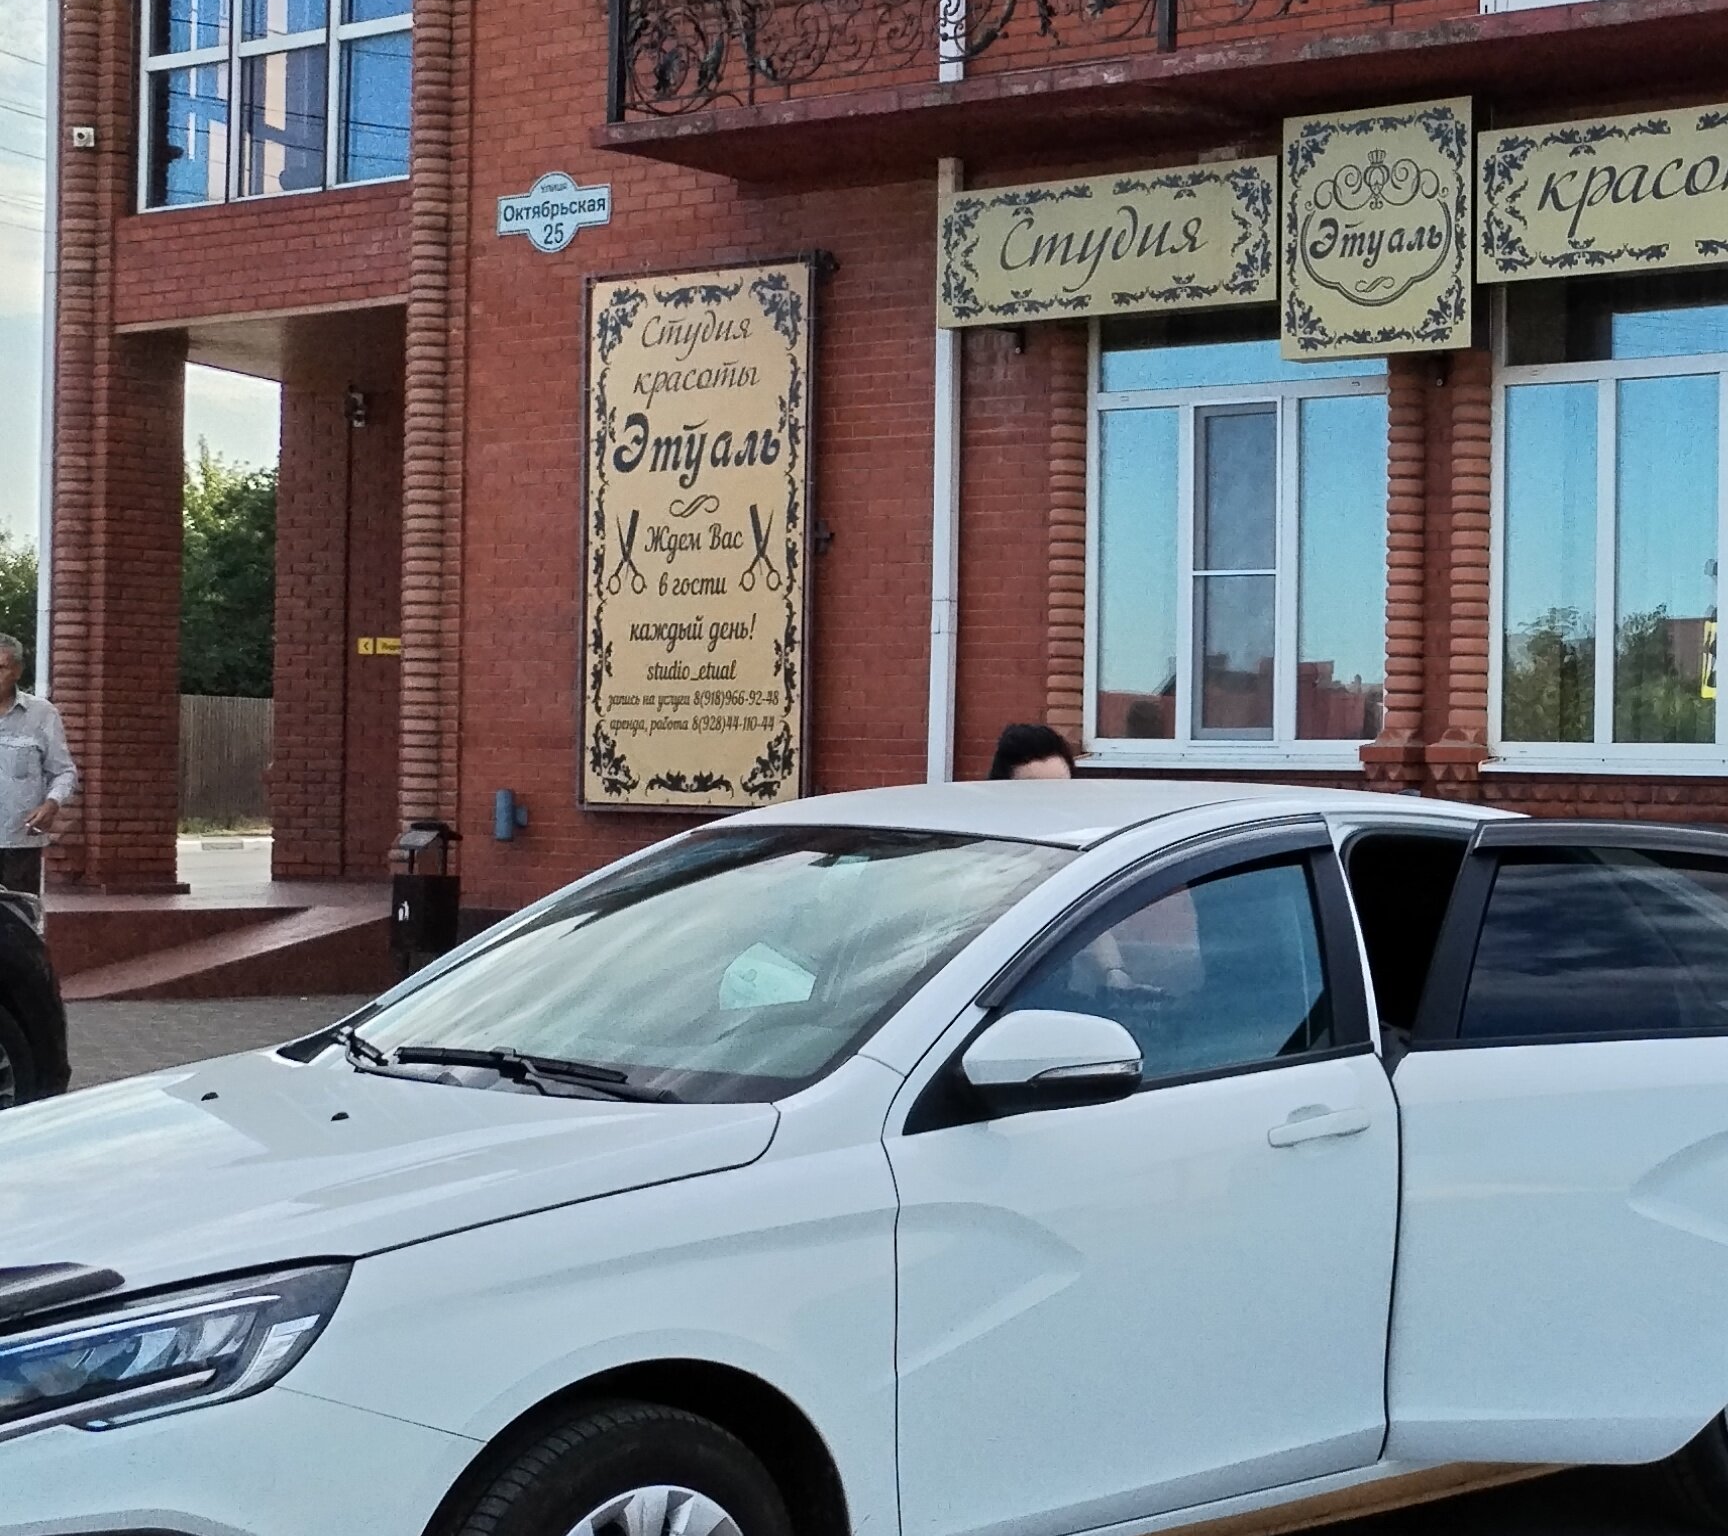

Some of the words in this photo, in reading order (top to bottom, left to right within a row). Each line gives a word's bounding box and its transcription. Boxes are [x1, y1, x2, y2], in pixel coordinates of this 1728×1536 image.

[503, 198, 606, 222] Октябрьская
[543, 223, 564, 245] 25
[1000, 205, 1208, 293] Студия
[1309, 217, 1443, 269] Этуаль
[641, 310, 753, 361] Студия
[633, 360, 760, 409] красоты
[613, 413, 781, 489] Этуаль
[645, 525, 702, 564] Ждем
[709, 523, 744, 550] Вас
[659, 572, 669, 596] в
[672, 577, 728, 596] гости
[629, 615, 704, 653] каждый
[707, 613, 757, 653] день!
[646, 659, 737, 681] studio_etual
[606, 695, 640, 713] запись
[643, 695, 655, 705] на
